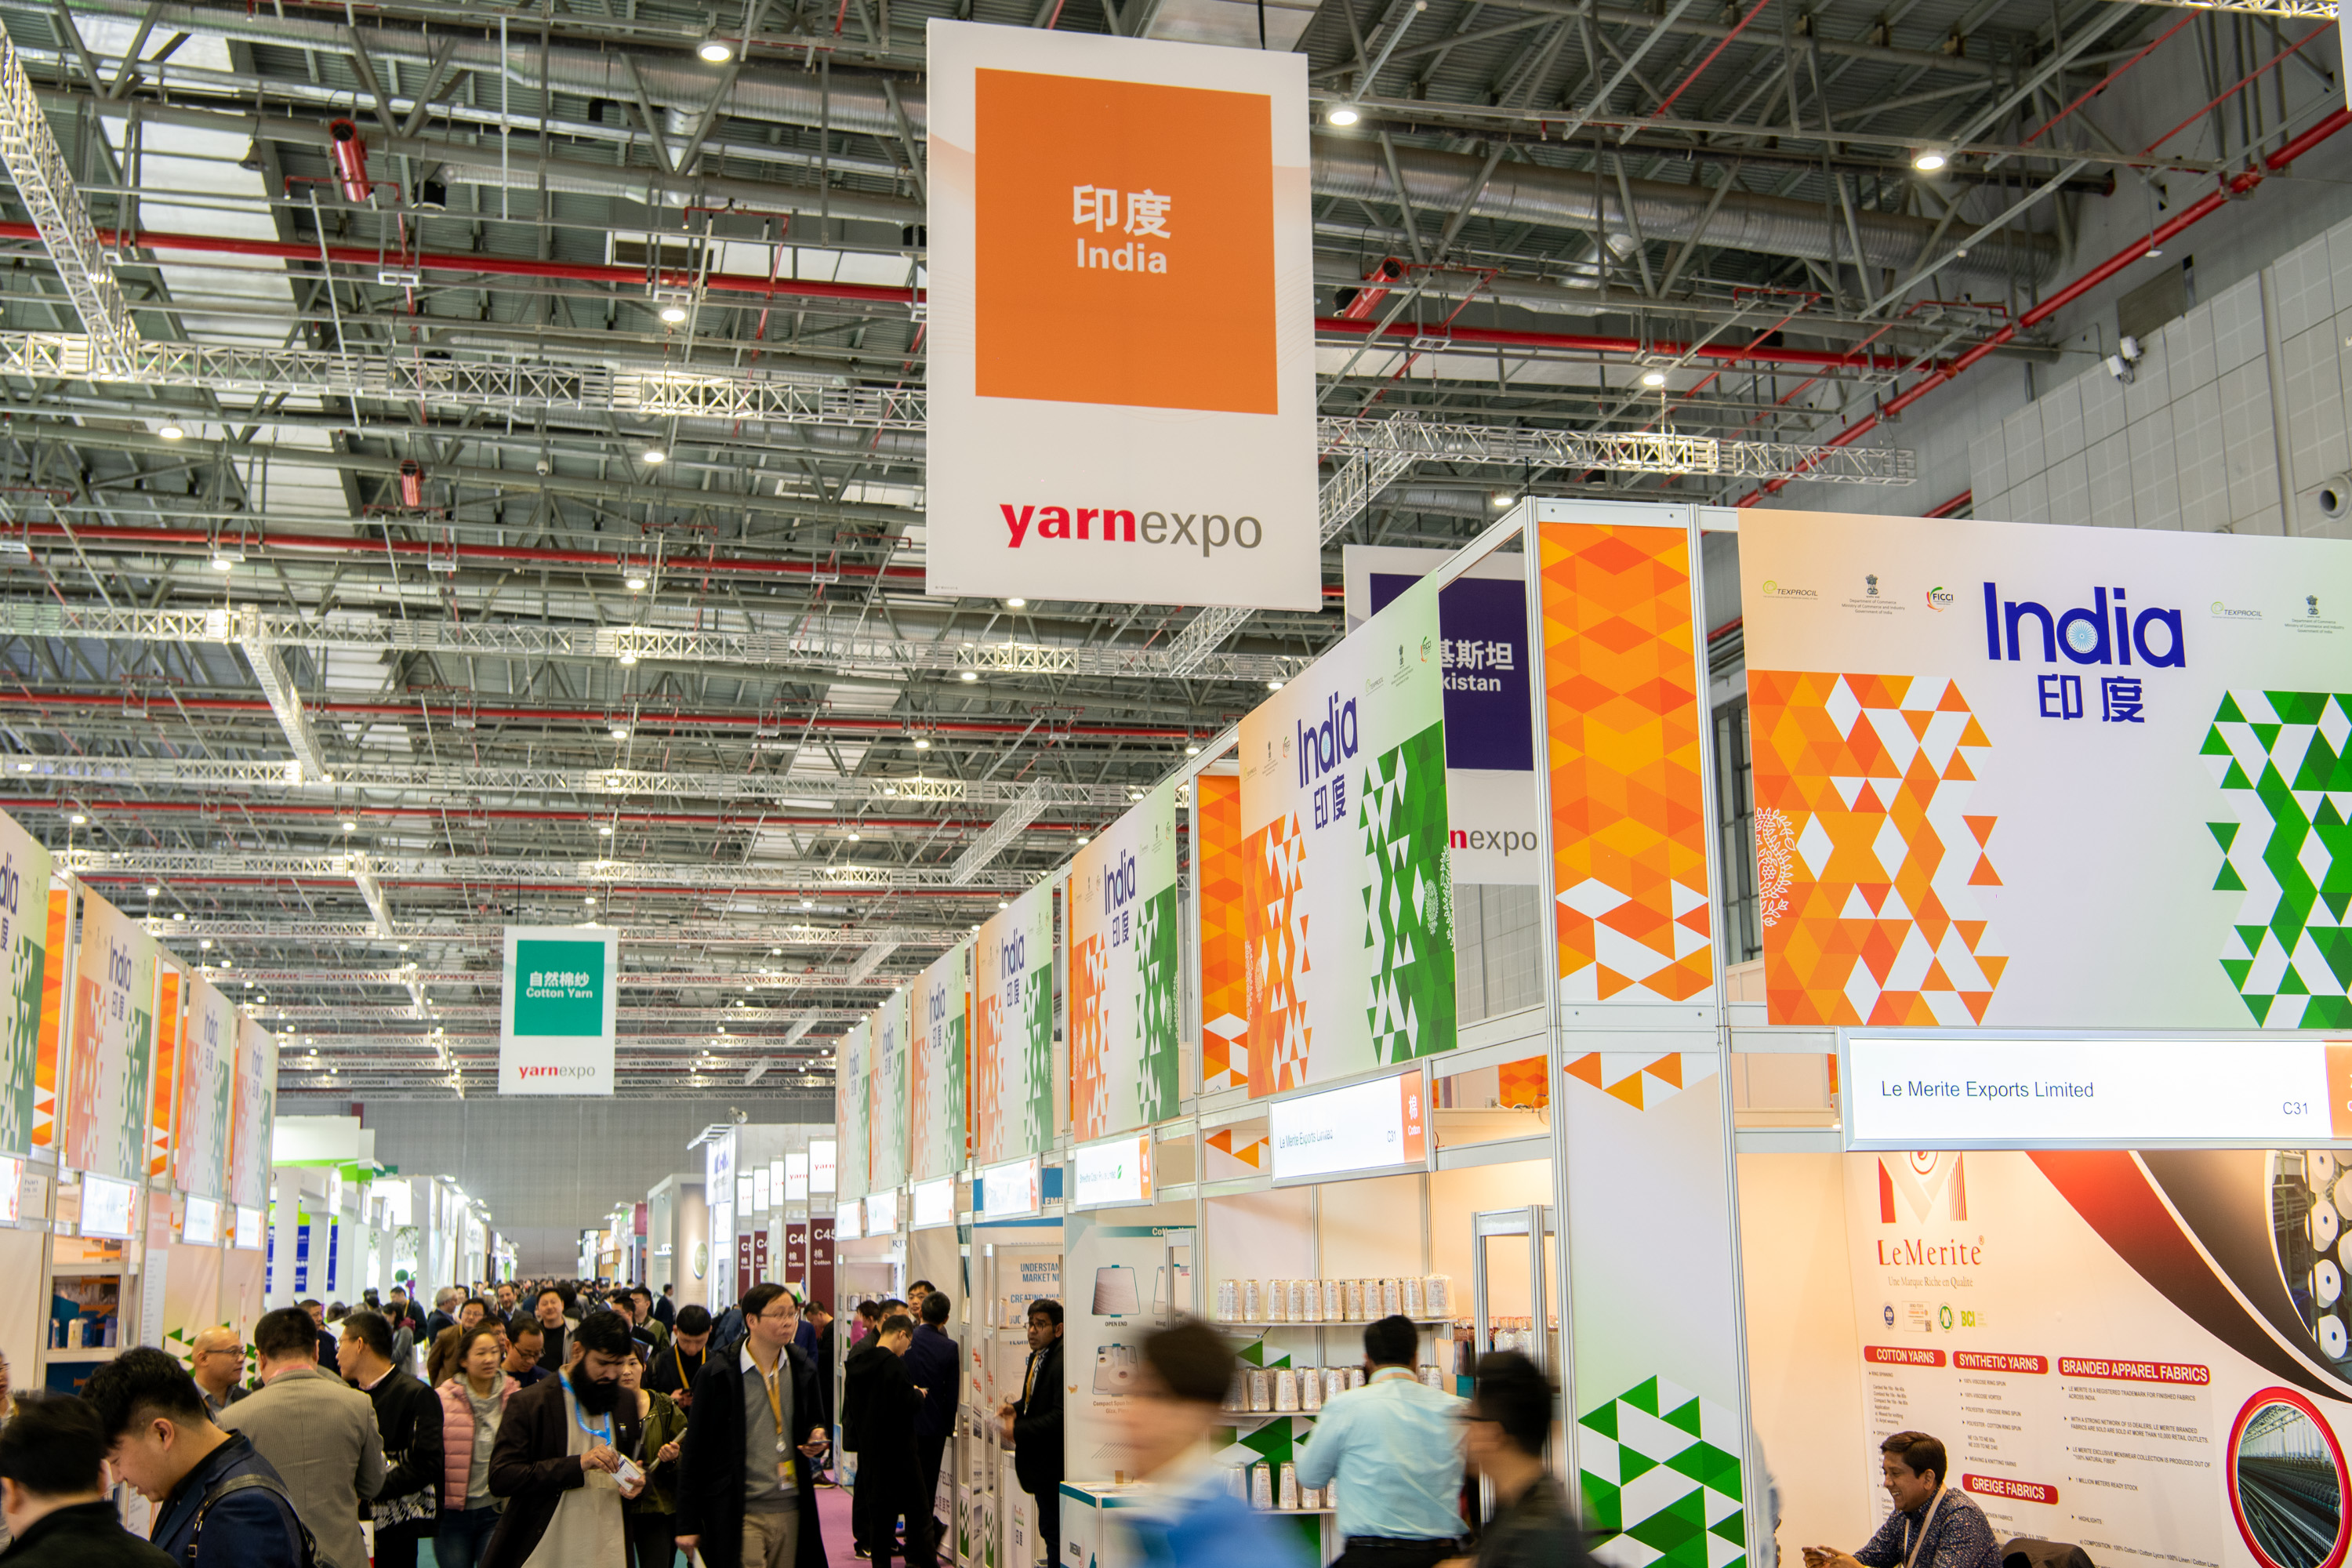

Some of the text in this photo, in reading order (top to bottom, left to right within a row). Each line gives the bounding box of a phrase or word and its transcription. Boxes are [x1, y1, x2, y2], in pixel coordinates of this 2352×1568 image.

[1073, 183, 1172, 239] 印度
[1076, 238, 1167, 274] India
[999, 503, 1262, 557] yarnexpo
[1777, 588, 1818, 597] TEXPROCIL
[1933, 593, 1954, 601] FICCI
[1983, 581, 2187, 669] India
[2038, 673, 2146, 724] 印度
[1298, 691, 1359, 789] India
[1314, 774, 1347, 830] 印度
[1105, 848, 1135, 916] India
[1112, 909, 1129, 948] 印度
[109, 935, 132, 992] India
[1002, 927, 1024, 980] India
[529, 971, 590, 988] 自然棉纱
[526, 988, 593, 998] Cotton Yarn
[1007, 978, 1020, 1007] 印度
[929, 982, 946, 1025] India
[883, 1022, 894, 1056] India
[519, 1065, 595, 1080] yarnexpo
[1882, 1080, 2094, 1101] Le Merite Exports Limited
[2283, 1102, 2307, 1115] C31
[1387, 1131, 1396, 1142] C31
[1408, 1125, 1421, 1136] Cotton
[1279, 1136, 1286, 1149] Le
[1022, 1273, 1051, 1283] MARKET
[1888, 1276, 1900, 1287] Une
[1900, 1276, 1923, 1289] Marque
[1924, 1276, 1941, 1287] Riche
[1950, 1276, 1973, 1289] Qualité
[1961, 1310, 1976, 1327] BCI
[1876, 1348, 1935, 1363] COTTON YARNS
[1959, 1353, 2039, 1371] SYNTHETIC YARNS
[2062, 1359, 2208, 1382] BRANDED APPAREL FABRICS
[2092, 1448, 2114, 1457] EXCLUSIVE
[2136, 1454, 2164, 1463] COLLECTION
[2169, 1457, 2194, 1466] PRODUCED
[1972, 1476, 2045, 1500] GREIGE FABRICS
[2192, 1558, 2207, 1566] Cotton
